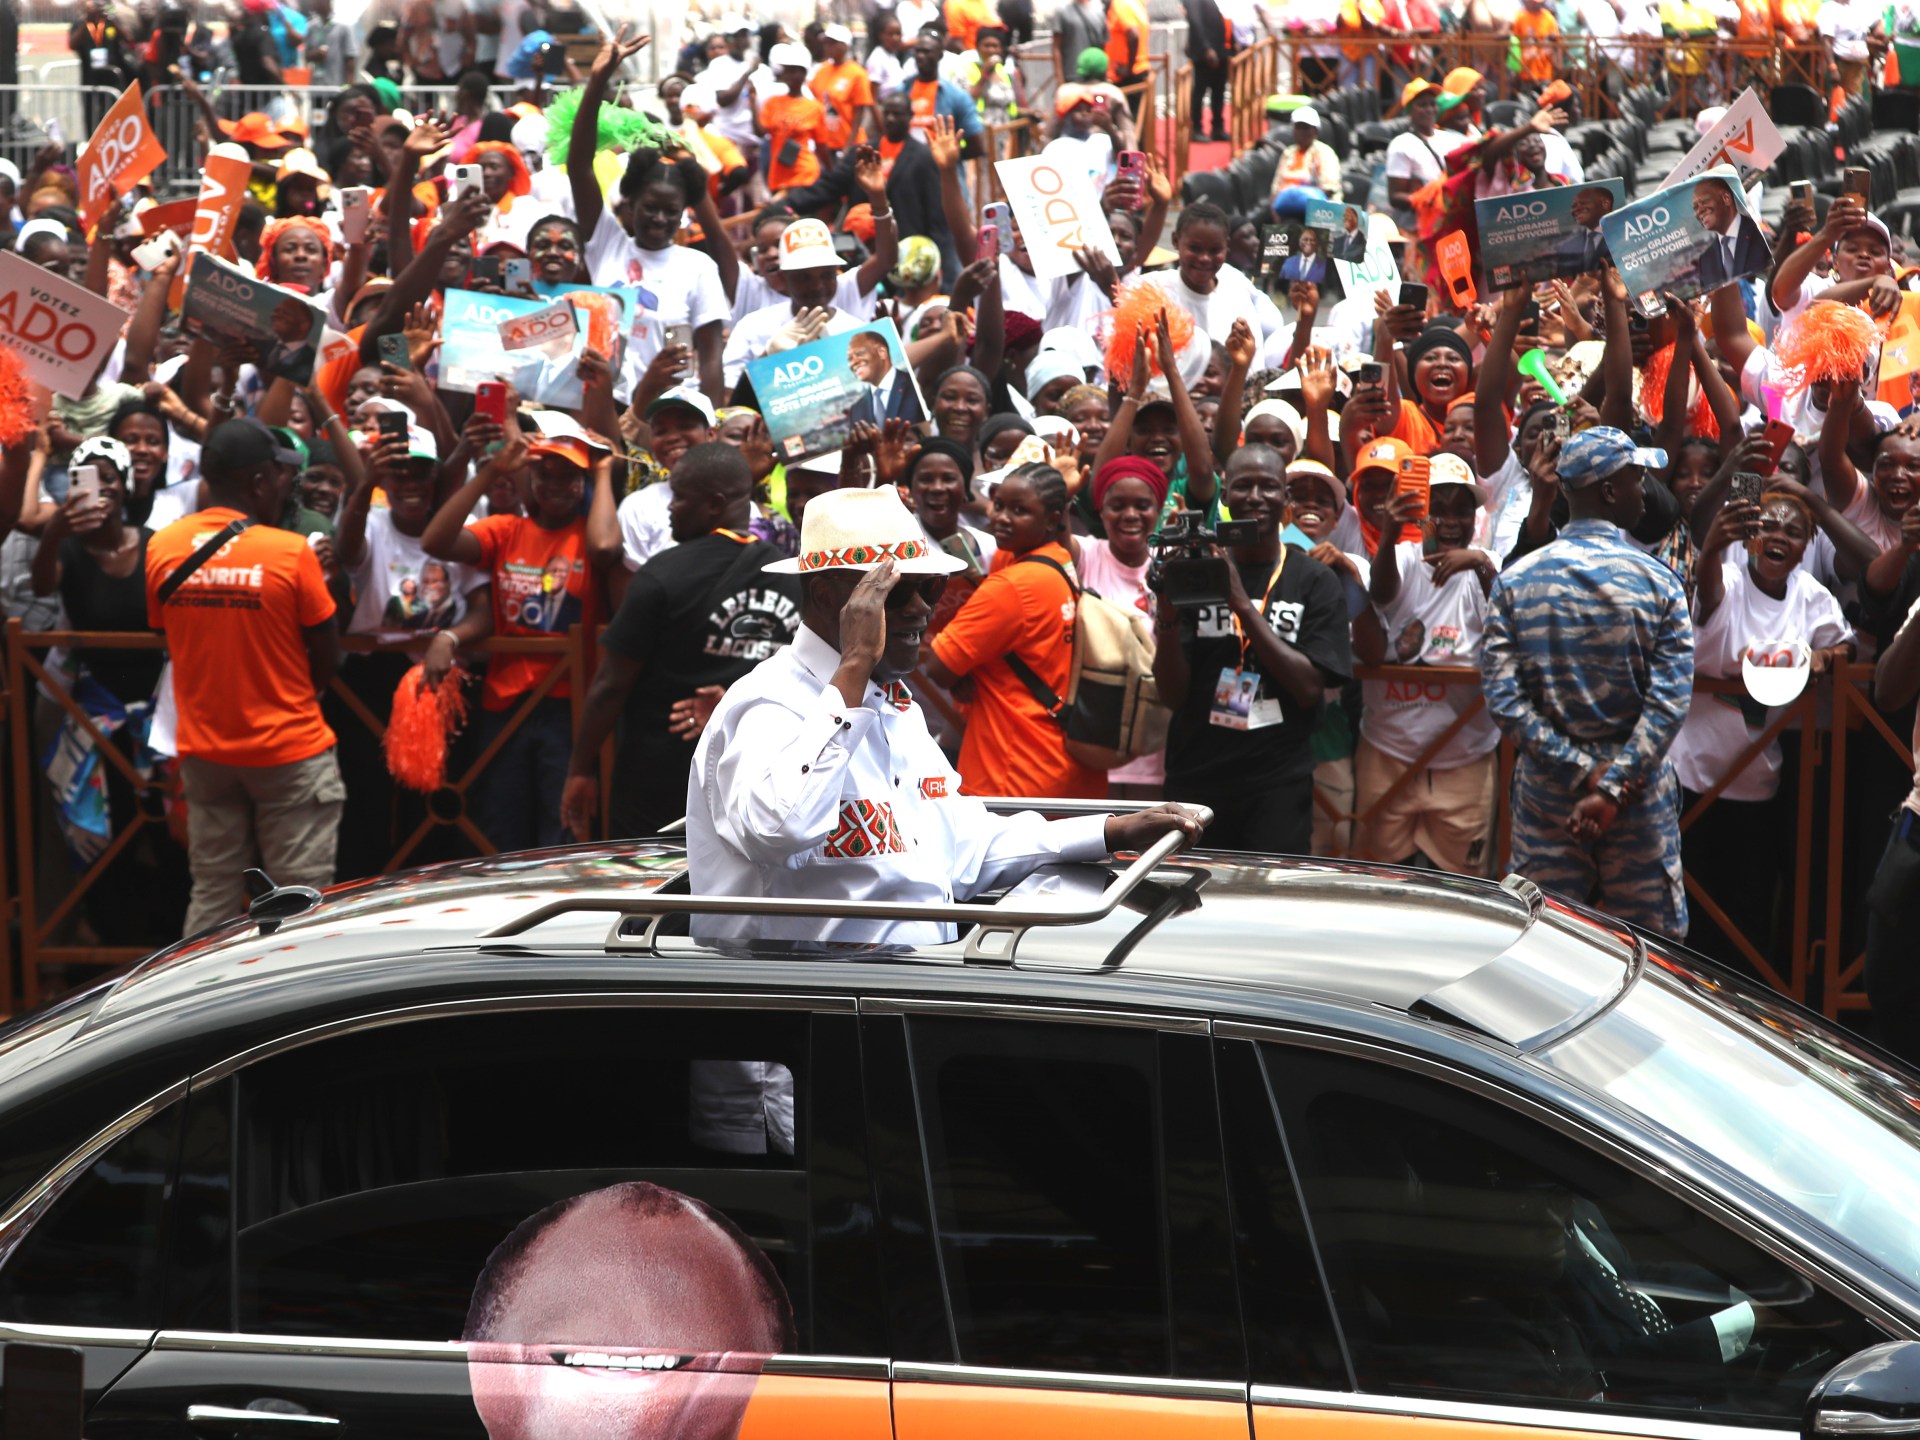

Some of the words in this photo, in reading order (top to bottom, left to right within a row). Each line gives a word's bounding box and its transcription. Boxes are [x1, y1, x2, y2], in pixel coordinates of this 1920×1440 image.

[89, 114, 142, 202] ADO
[187, 174, 226, 253] AD
[1496, 201, 1547, 222] ADO
[1623, 206, 1670, 241] ADO
[1268, 233, 1289, 243] ADO
[1516, 219, 1560, 233] GRANDE
[1517, 226, 1560, 240] D'IVOIRE
[1647, 227, 1688, 250] GRANDE
[1264, 248, 1289, 257] NATION
[1444, 241, 1463, 259] ADO
[1624, 254, 1651, 271] CÔTE
[1651, 236, 1693, 260] D'IVOIRE
[206, 270, 255, 301] ADO
[30, 287, 81, 317] VOTEZ
[0, 290, 96, 362] ADO
[508, 312, 570, 341] ADO
[773, 356, 824, 387] ADO
[165, 563, 263, 587] CURITÉ
[703, 635, 784, 660] LACOST
[1384, 681, 1446, 702] ADO
